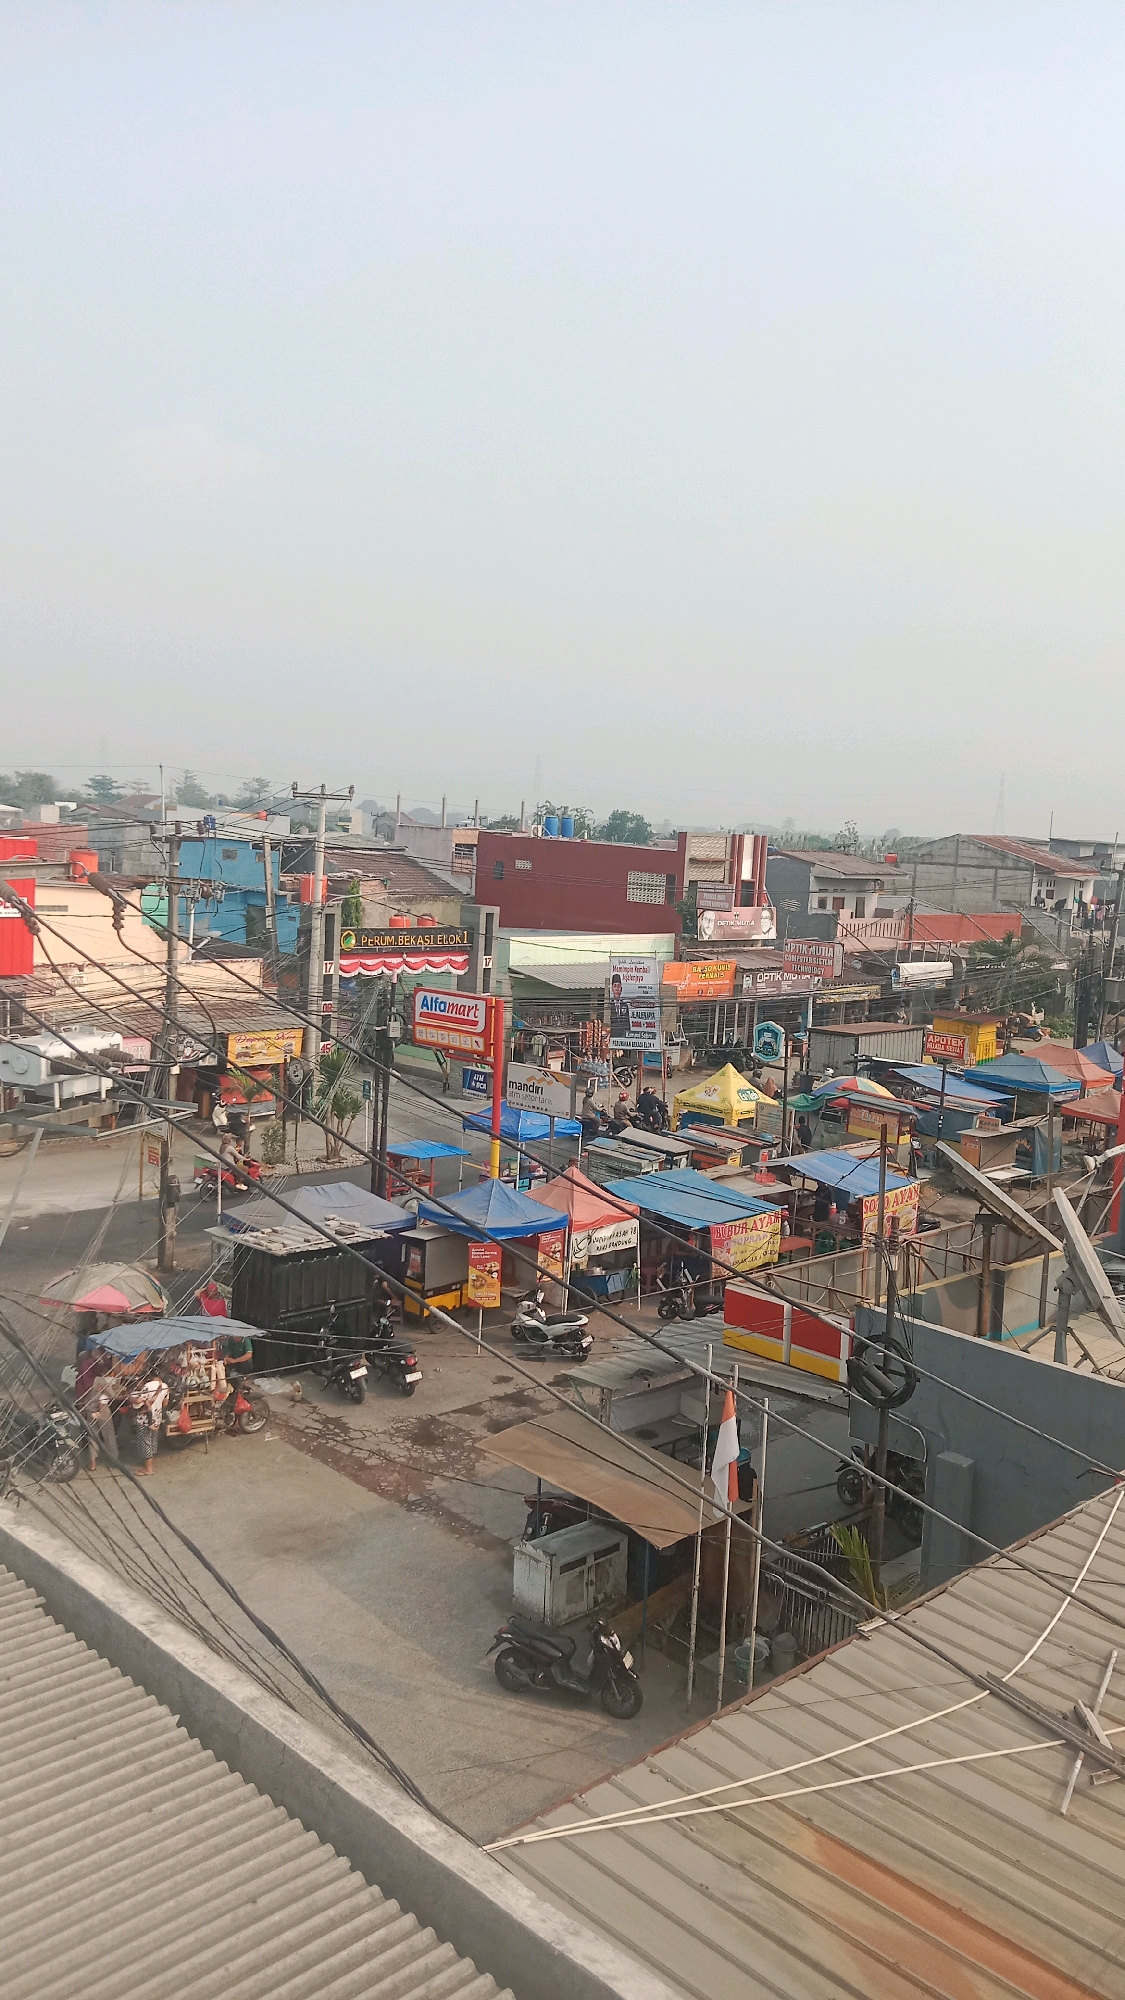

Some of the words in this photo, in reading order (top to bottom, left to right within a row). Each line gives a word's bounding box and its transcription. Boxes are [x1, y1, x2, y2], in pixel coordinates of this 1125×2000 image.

[399, 934, 435, 946] BEKASI
[437, 934, 462, 945] ELOK
[463, 930, 469, 944] 1
[809, 945, 834, 957] MUTIA
[324, 962, 334, 974] 17
[484, 957, 493, 968] 17
[692, 965, 713, 973] BASO
[792, 964, 825, 975] TECHNOLOGY
[757, 972, 782, 982] OPTIK
[322, 1003, 333, 1013] 08
[420, 995, 480, 1019] Alfamart
[928, 1035, 964, 1047] APOTEK
[508, 1080, 544, 1096] mandiri
[891, 1184, 919, 1208] AYAM
[715, 1220, 748, 1240] BUBUR
[750, 1210, 780, 1233] AYAM
